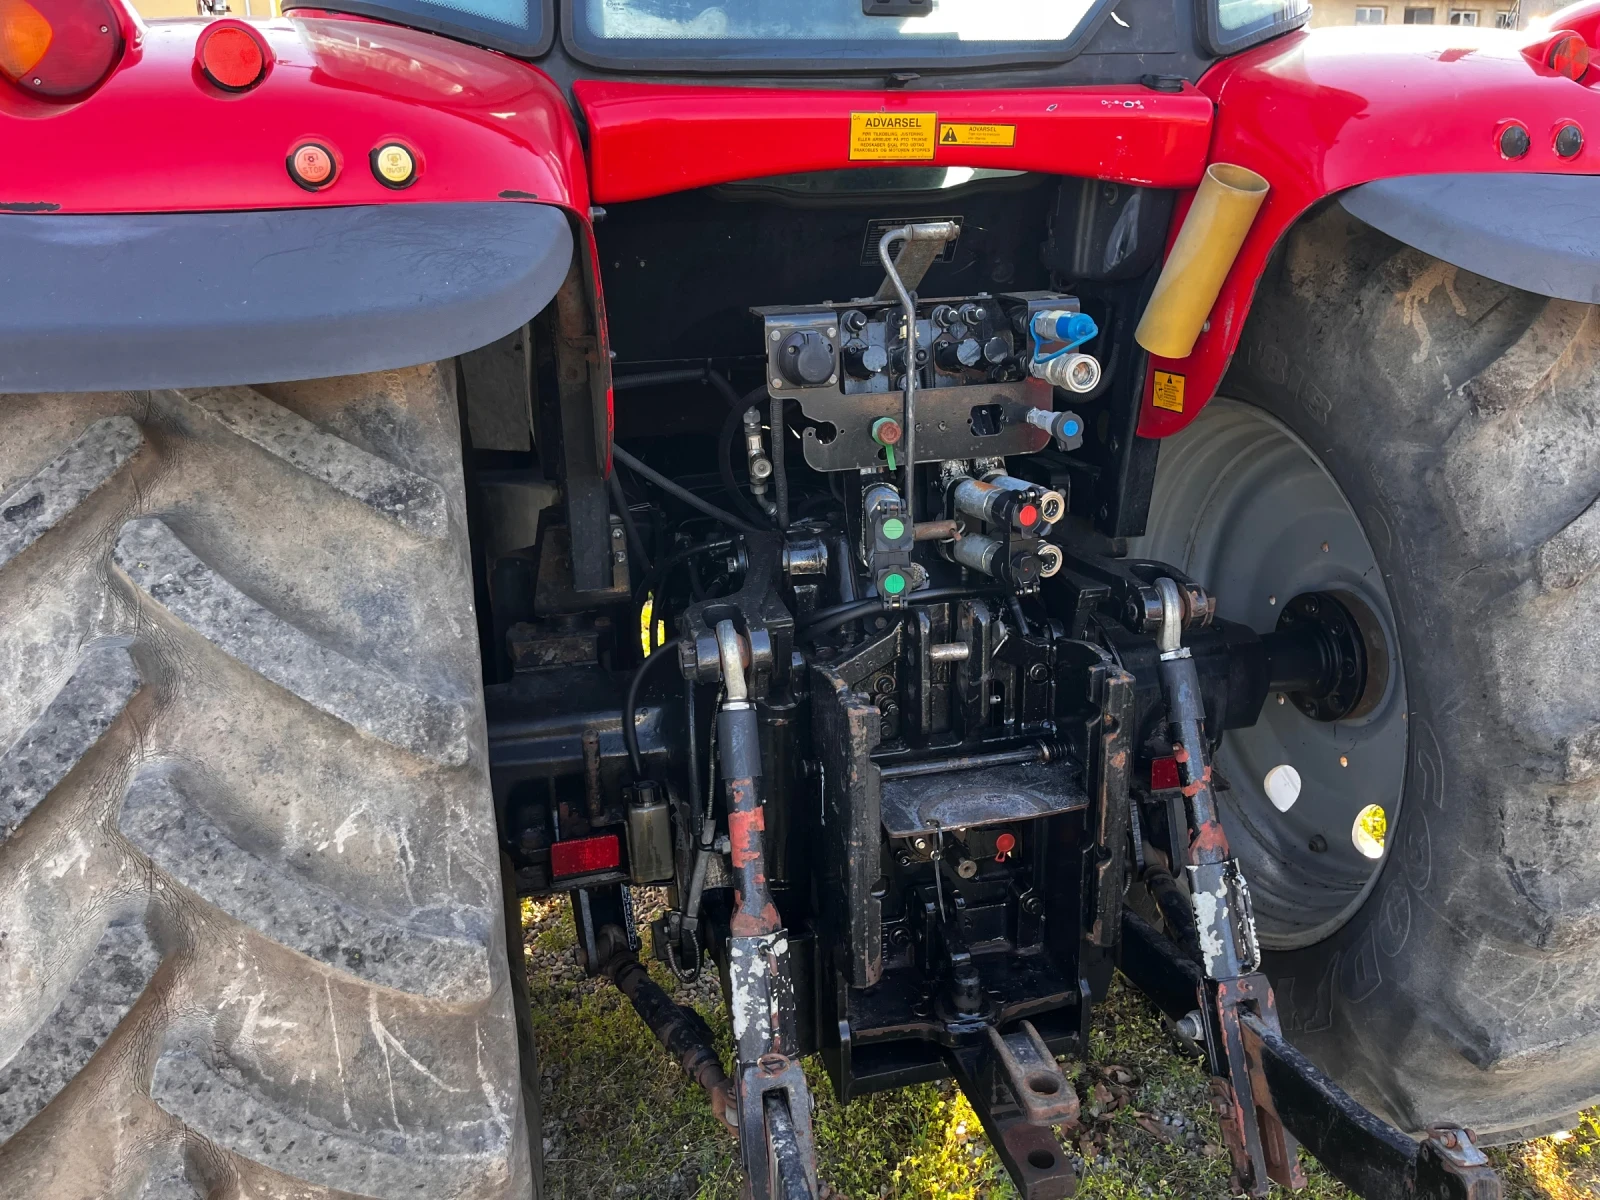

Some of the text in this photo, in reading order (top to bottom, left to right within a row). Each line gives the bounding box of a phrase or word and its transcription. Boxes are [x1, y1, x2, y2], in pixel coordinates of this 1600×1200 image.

[865, 118, 922, 128] ADVARSEL
[302, 166, 324, 174] STOP
[386, 166, 406, 174] ON/OFF
